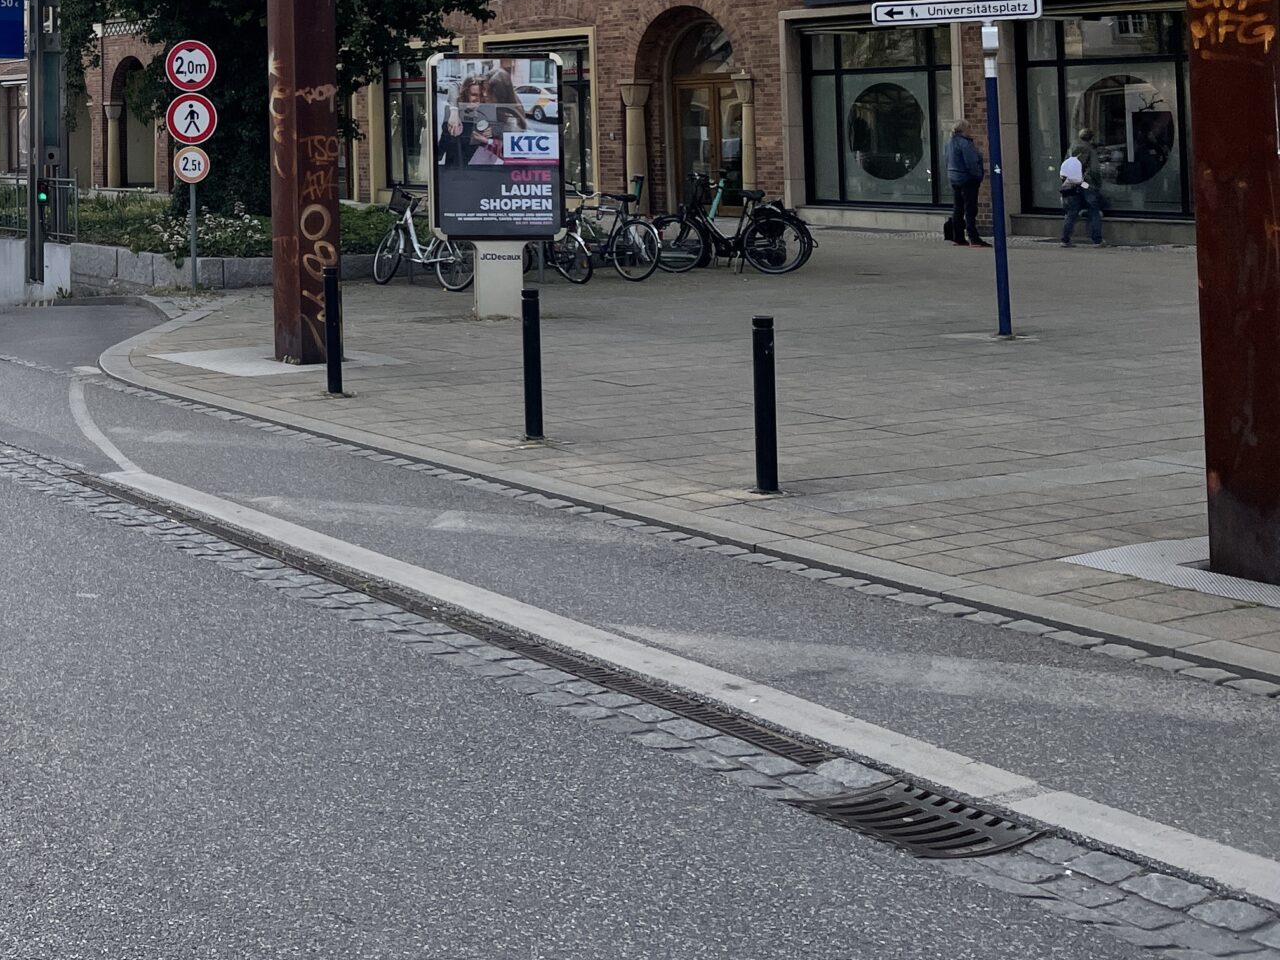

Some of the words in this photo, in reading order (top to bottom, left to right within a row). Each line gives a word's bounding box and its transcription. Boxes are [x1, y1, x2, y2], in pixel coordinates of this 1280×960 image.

[927, 2, 1029, 17] Universitätsplatz
[175, 56, 207, 77] 2,0m
[510, 135, 550, 152] KTC
[511, 169, 552, 181] GUTE
[501, 184, 553, 196] LAUNE
[480, 198, 553, 211] SHOPPEN
[480, 253, 521, 261] JCDecaux
